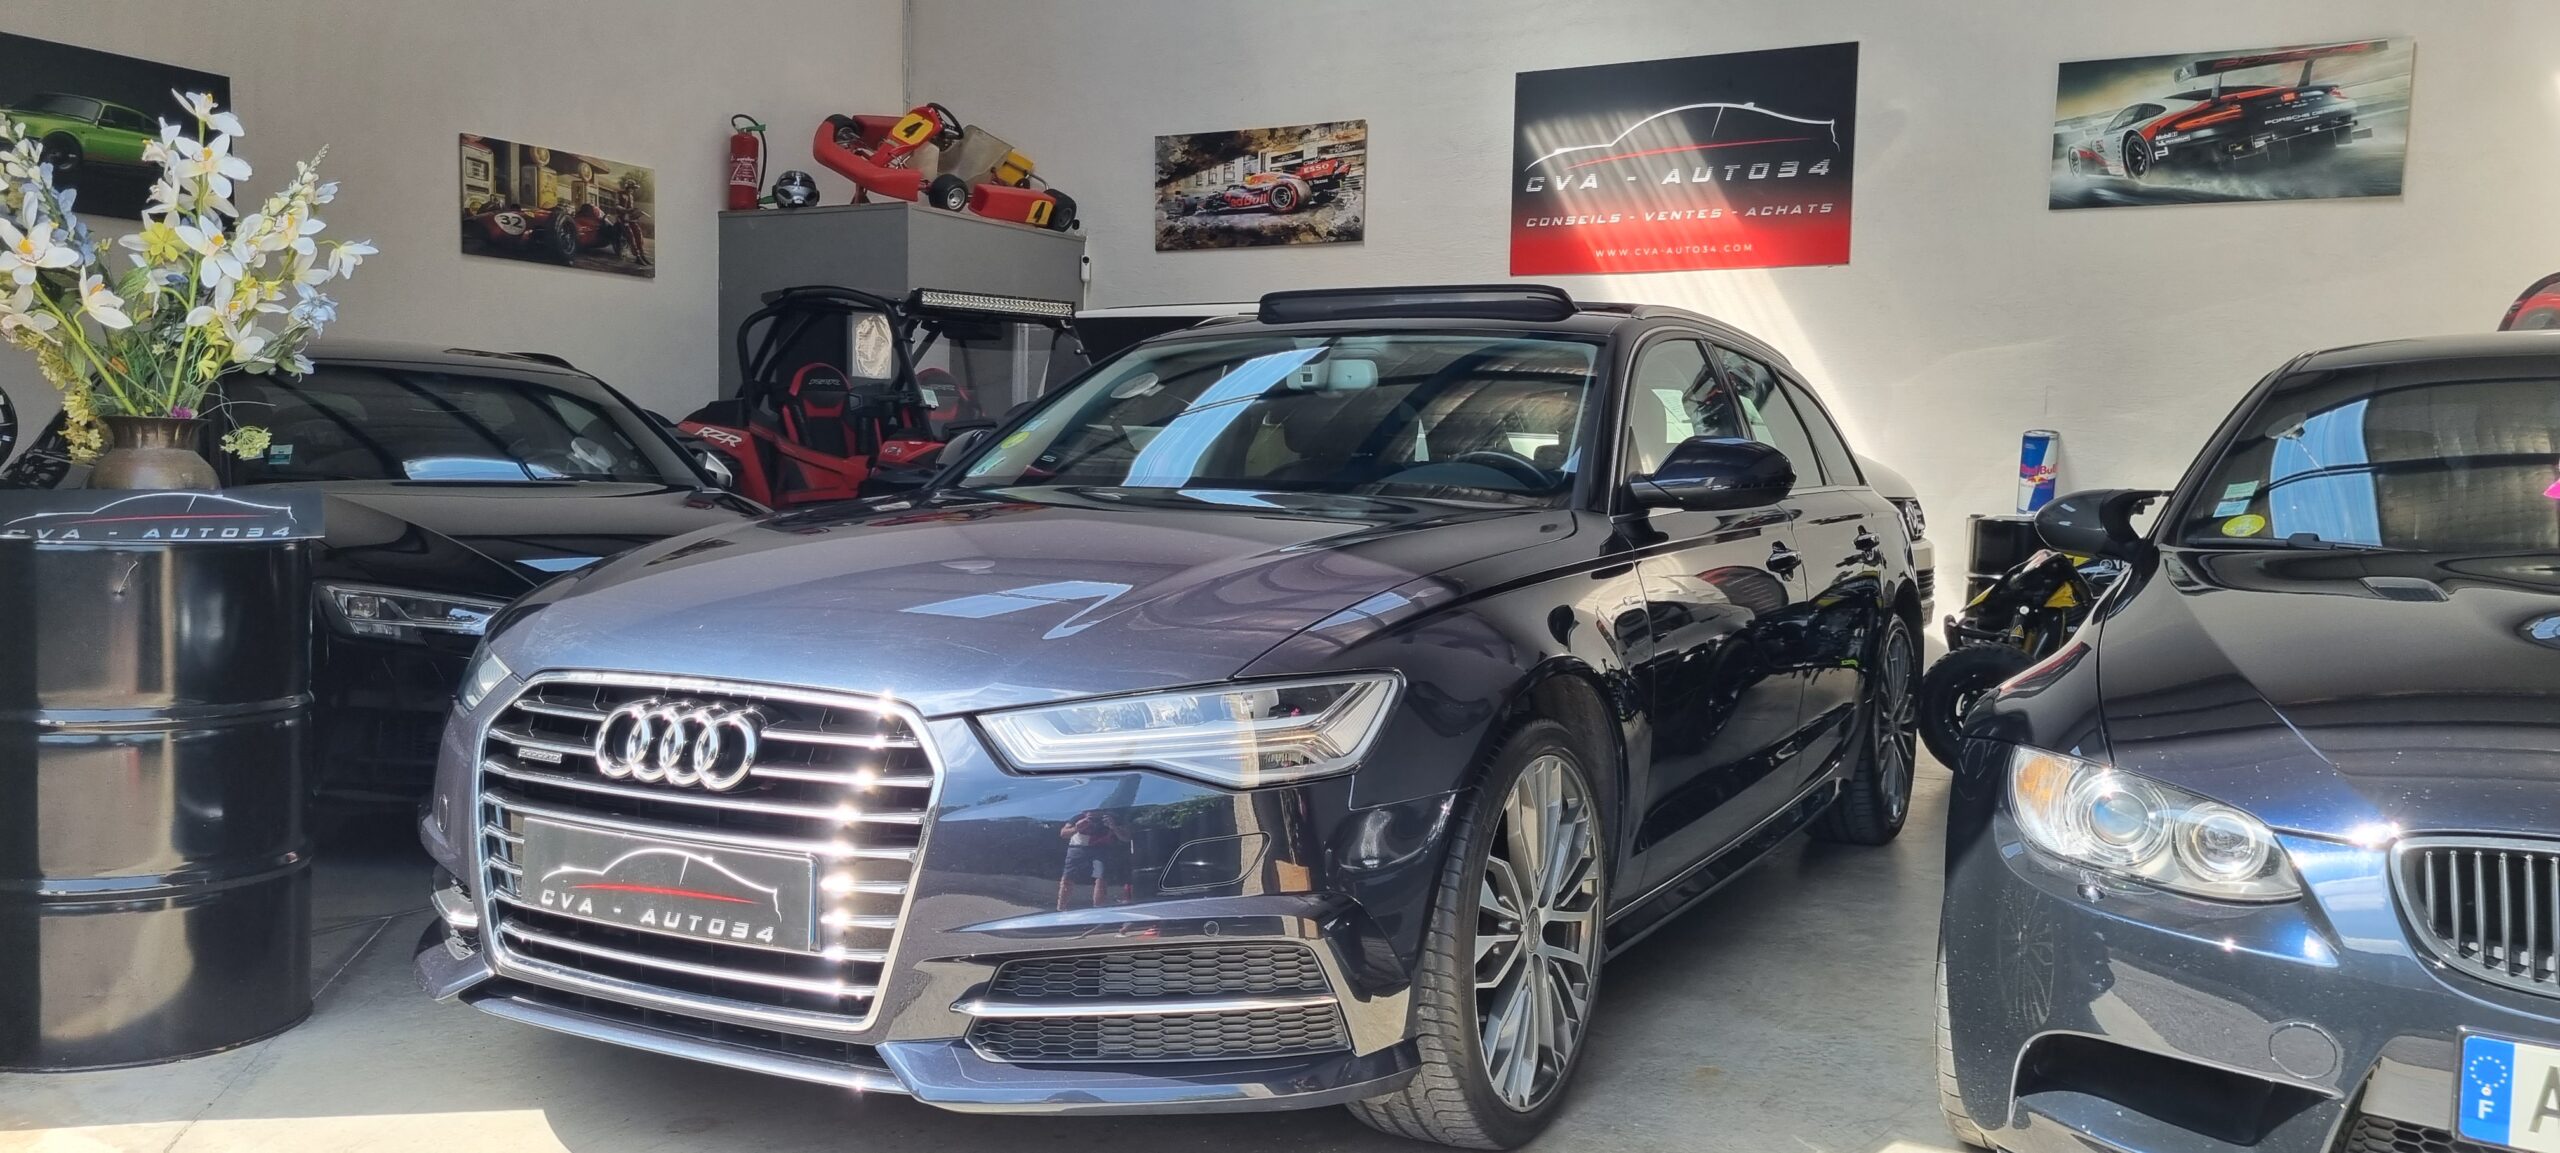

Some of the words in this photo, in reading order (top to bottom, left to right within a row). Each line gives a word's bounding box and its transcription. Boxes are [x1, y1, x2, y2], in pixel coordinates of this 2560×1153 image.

[2264, 112, 2310, 125] PORSCHE
[902, 121, 924, 138] 4
[1303, 163, 1330, 173] ESSO
[1525, 173, 1599, 194] CVA
[1661, 158, 1832, 186] AUTO34
[1033, 201, 1046, 223] 4
[1525, 212, 1621, 228] CONSEILS
[1644, 207, 1723, 223] VENTES
[1744, 202, 1834, 217] ACHATS
[500, 214, 524, 230] 32
[1595, 243, 1753, 258] WWW.CVA-AUTO34.COM
[694, 426, 742, 447] RZR
[142, 526, 291, 538] AUTO34
[541, 888, 593, 915] CVA
[640, 908, 775, 942] AUTO34
[2477, 1099, 2495, 1120] F
